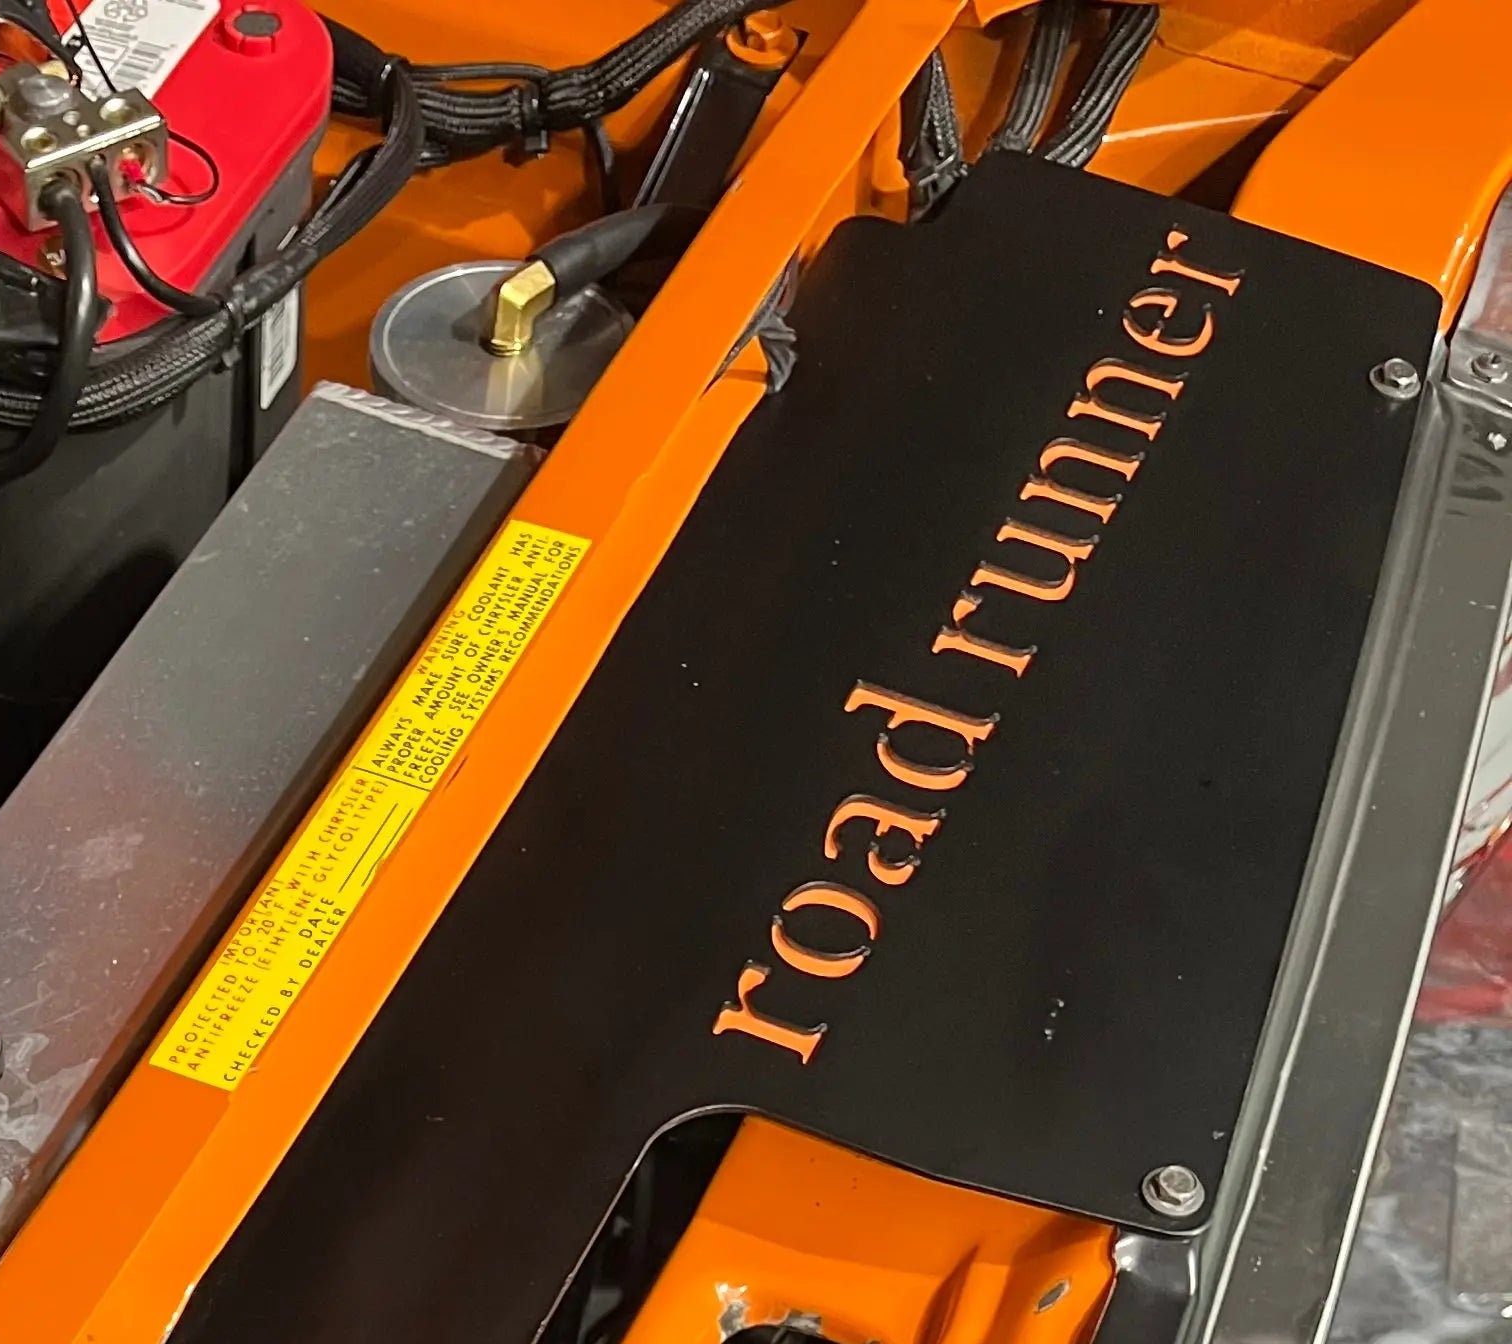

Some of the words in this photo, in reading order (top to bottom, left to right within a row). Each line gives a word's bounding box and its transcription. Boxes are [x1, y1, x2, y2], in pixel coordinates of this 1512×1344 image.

[371, 717, 412, 768] ALWAYS
[412, 672, 443, 706] MAKE
[441, 632, 468, 660] SURE
[467, 567, 510, 621] COOLANT
[510, 534, 532, 556] HAS
[387, 728, 426, 773] PROPER
[424, 666, 466, 720] AMOUNT
[464, 642, 480, 657] OF
[478, 577, 524, 635] CHRYSLER
[403, 728, 446, 778] FREEZE
[449, 692, 470, 711] SEE
[507, 573, 548, 621] MANUAL
[544, 541, 565, 563] FOR
[412, 610, 465, 674] WARNING
[419, 728, 464, 783] COOLING
[461, 669, 503, 720] SYSTEMS
[499, 547, 580, 662] RECOMMENDATIONS
[712, 679, 1001, 1067] road
[929, 222, 1248, 679] runner
[169, 975, 237, 1063] PROTECTED
[235, 947, 256, 965] TO
[287, 851, 320, 889] WITH
[319, 779, 368, 842] CHRYSLER
[221, 878, 282, 964] IMPORTANT
[224, 1007, 280, 1081] CHECKED
[280, 978, 299, 997] BY
[299, 908, 346, 968] DEALER
[298, 898, 334, 938] DATE
[188, 976, 258, 1071] ANTIFREEZE
